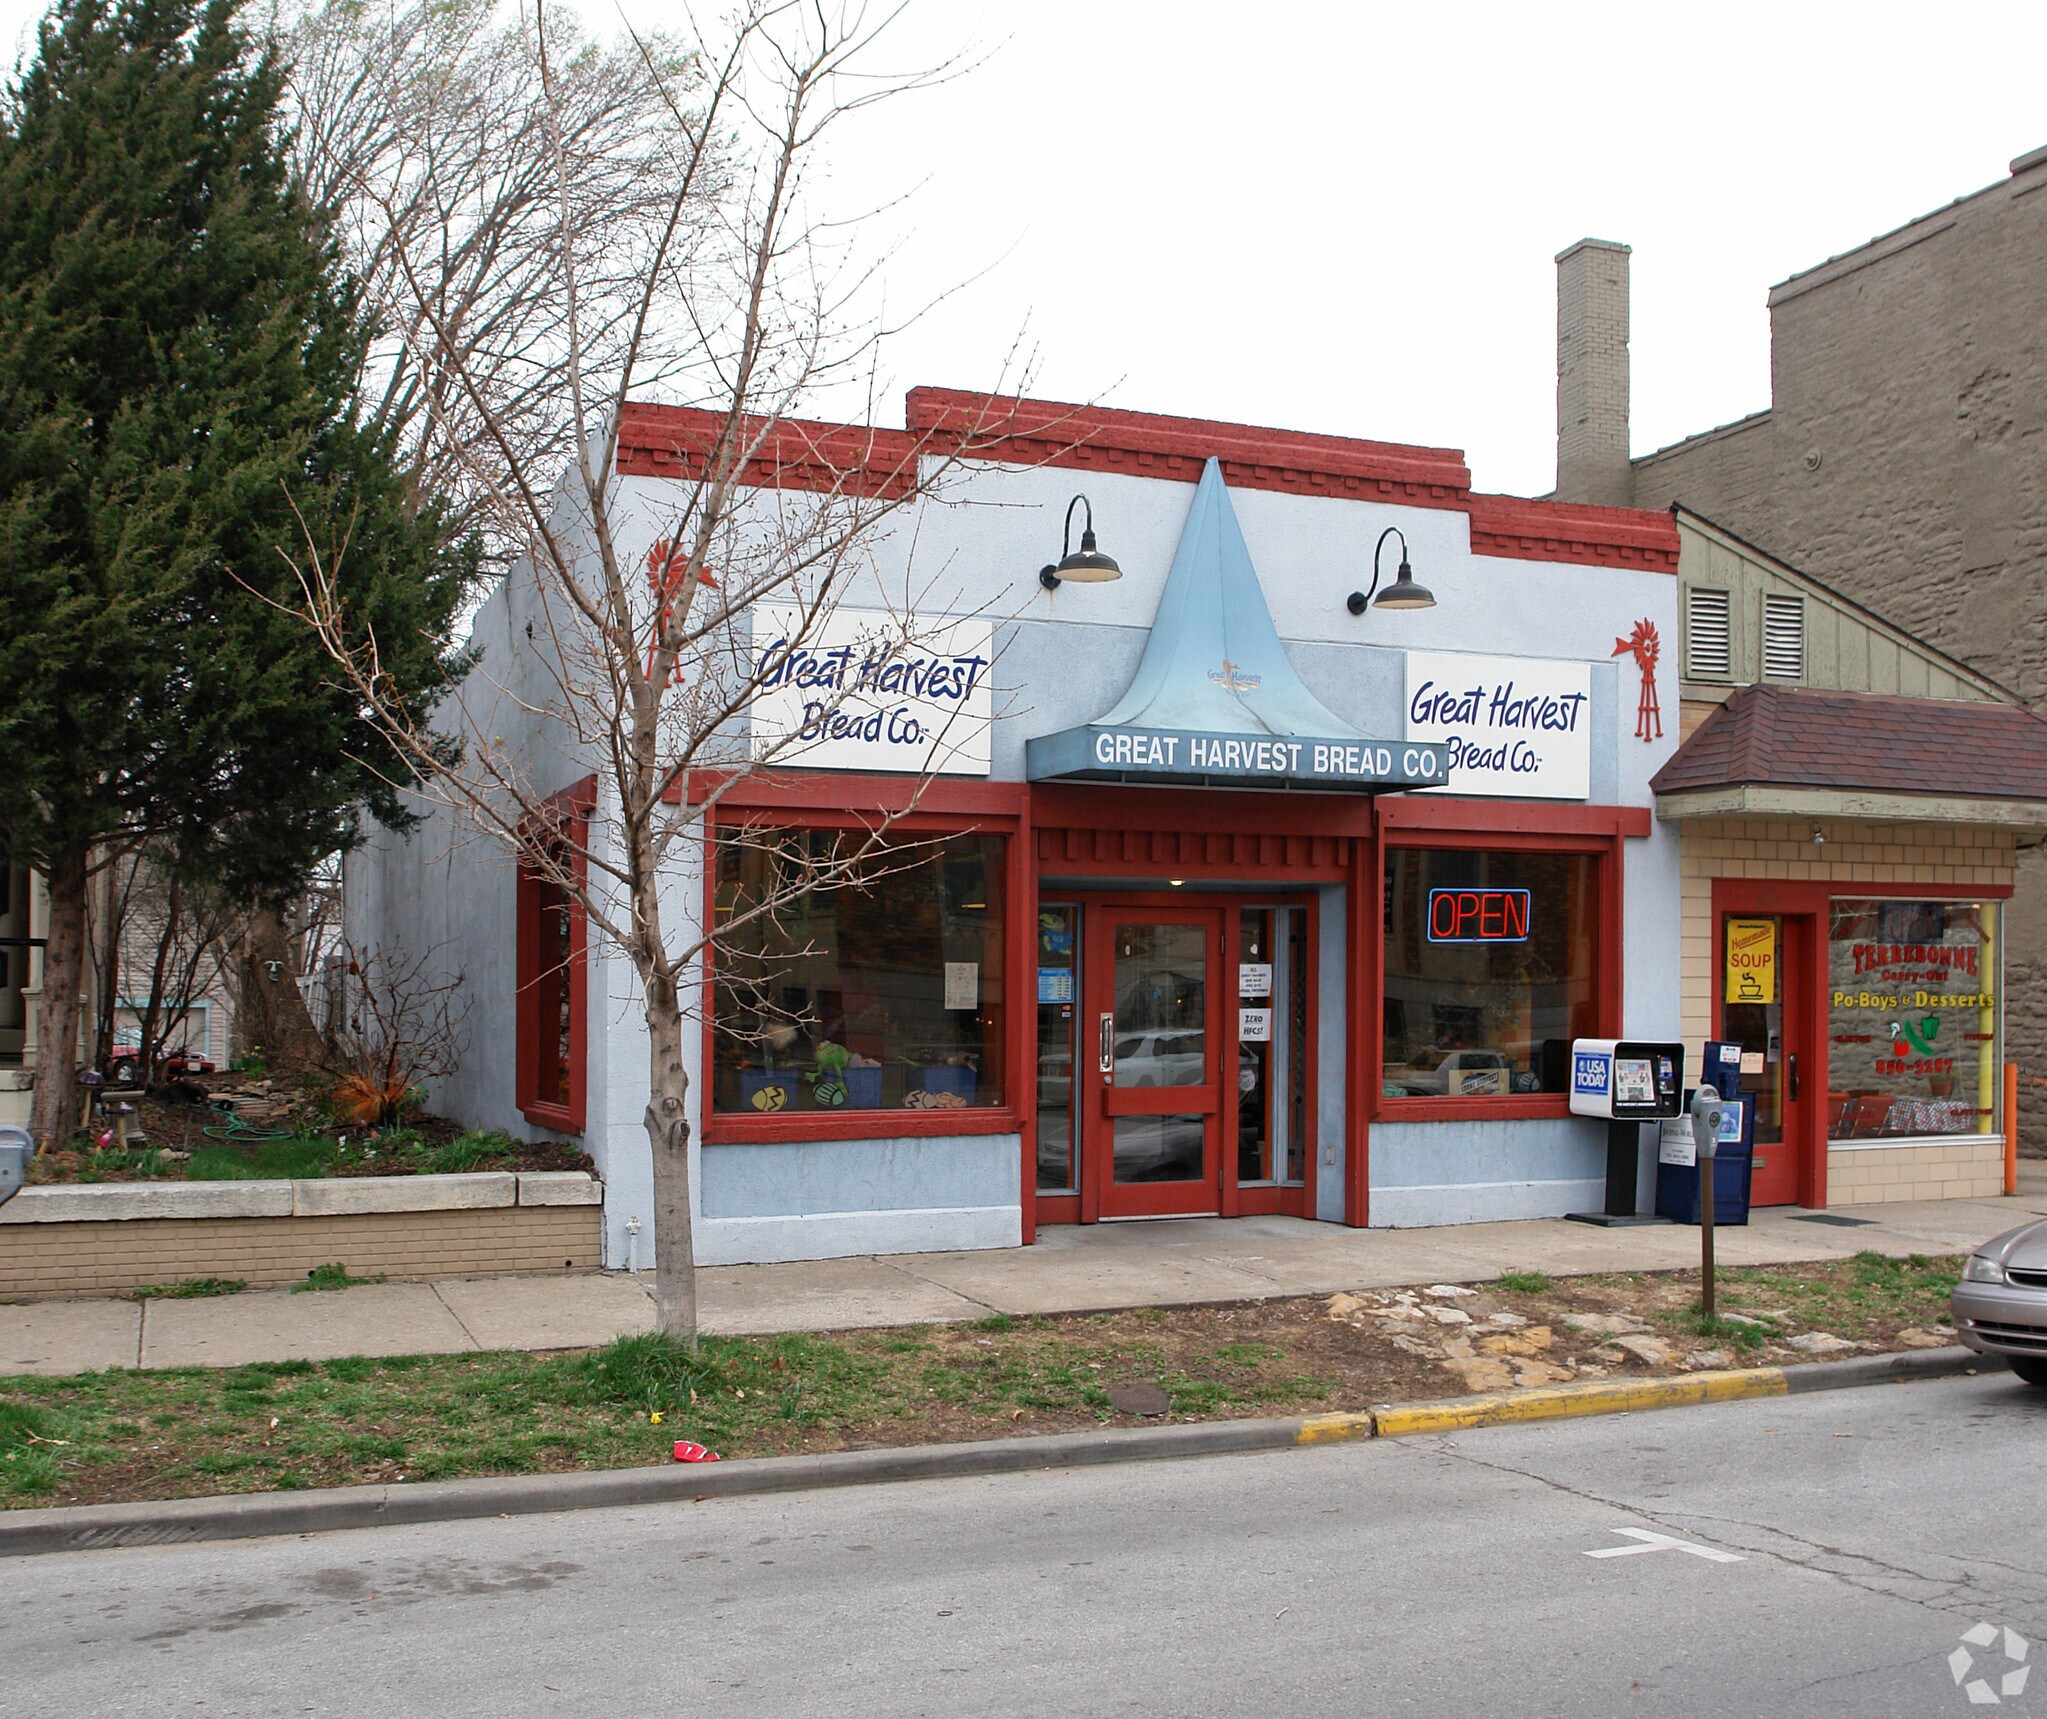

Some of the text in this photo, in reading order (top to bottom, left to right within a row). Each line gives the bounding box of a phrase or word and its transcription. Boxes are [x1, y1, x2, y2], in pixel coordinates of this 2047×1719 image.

[757, 639, 988, 700] Great Harvest
[800, 702, 925, 744] Bread Co.
[1411, 681, 1588, 732] Great Harvest
[1096, 733, 1443, 778] GREAT HARVEST BREAD CO.
[1446, 736, 1539, 772] Bread Co.
[1432, 893, 1527, 937] OPEN
[1731, 953, 1772, 968] SOUP
[1852, 944, 1978, 977] TERREBONNE
[1881, 968, 1949, 984] Carry-Out
[1833, 991, 1898, 1011] Po-Boys
[1914, 990, 1995, 1008] Desserts
[1245, 1015, 1263, 1023] ZERO
[1577, 1072, 1607, 1088] TODAY
[1586, 1060, 1606, 1074] USA
